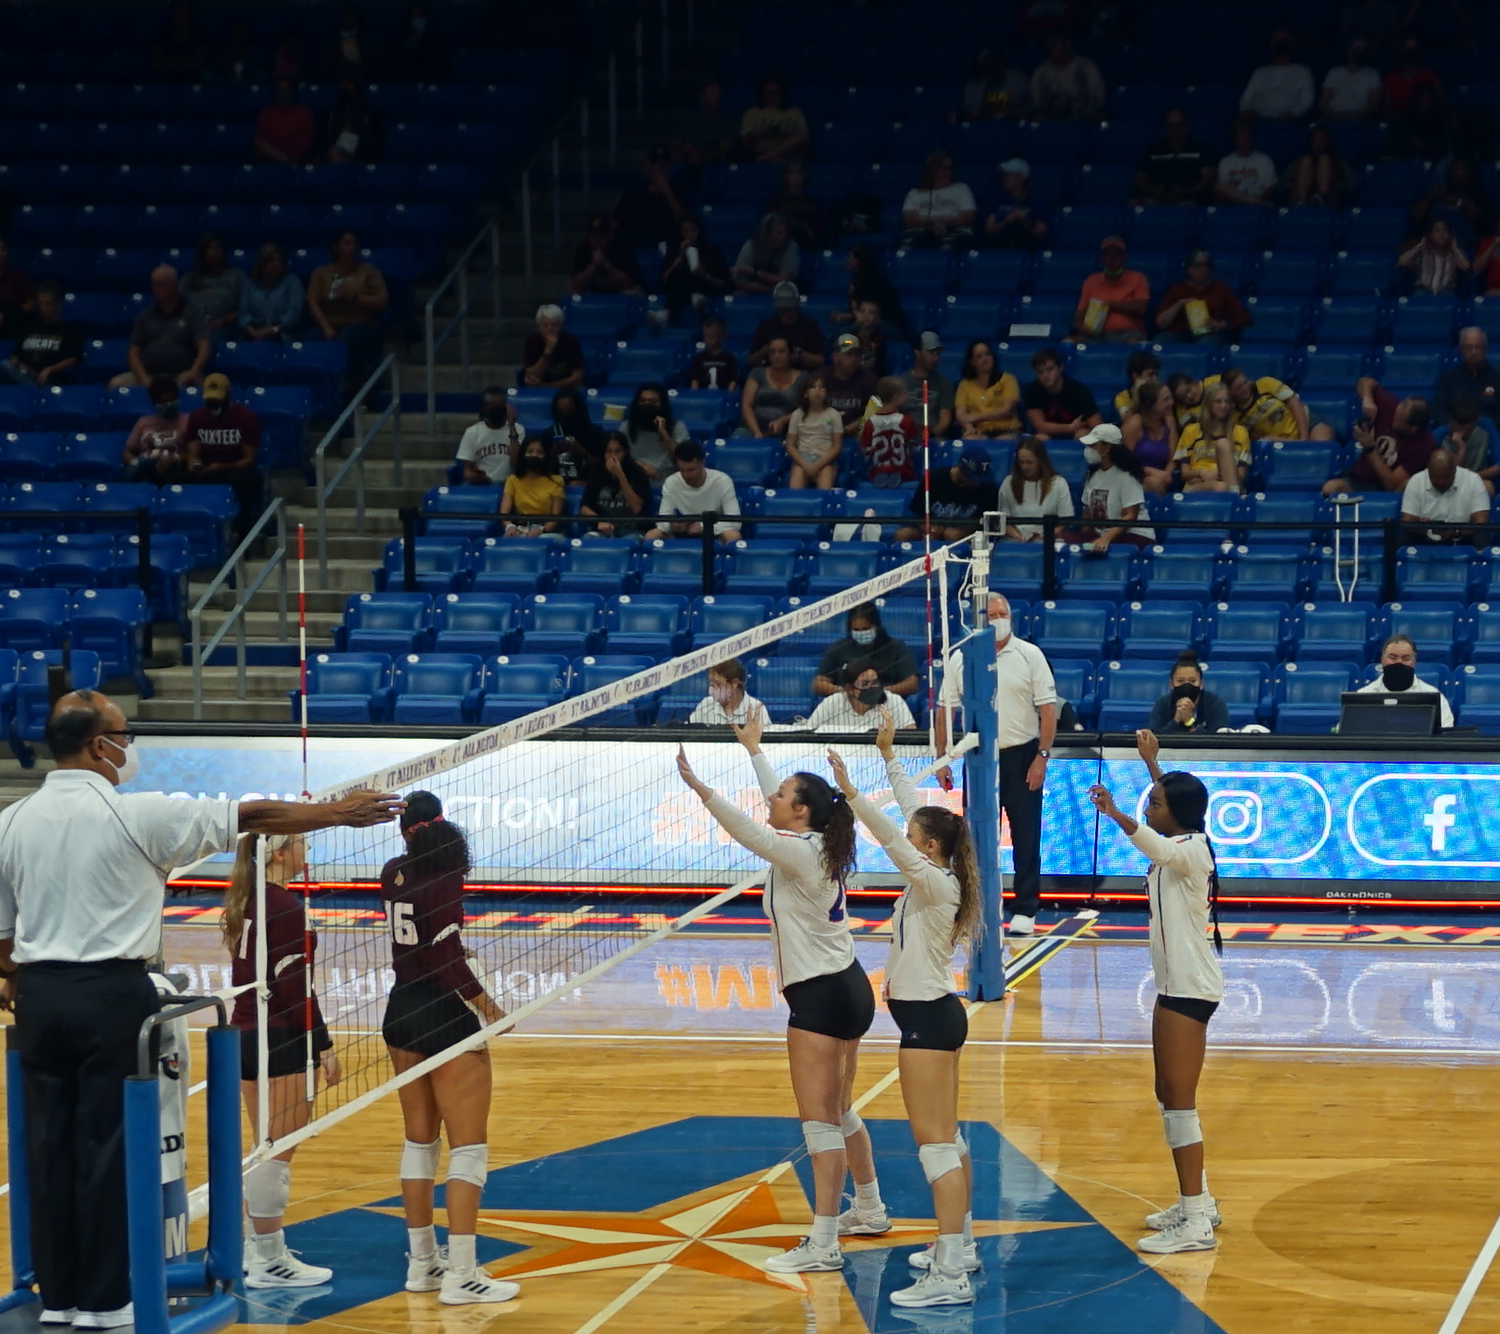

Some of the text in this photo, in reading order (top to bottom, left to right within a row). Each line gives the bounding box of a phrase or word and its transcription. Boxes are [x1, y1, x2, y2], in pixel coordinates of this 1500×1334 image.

[198, 428, 241, 444] SIXTEEN
[871, 434, 906, 466] 29
[443, 795, 579, 830] CTION!
